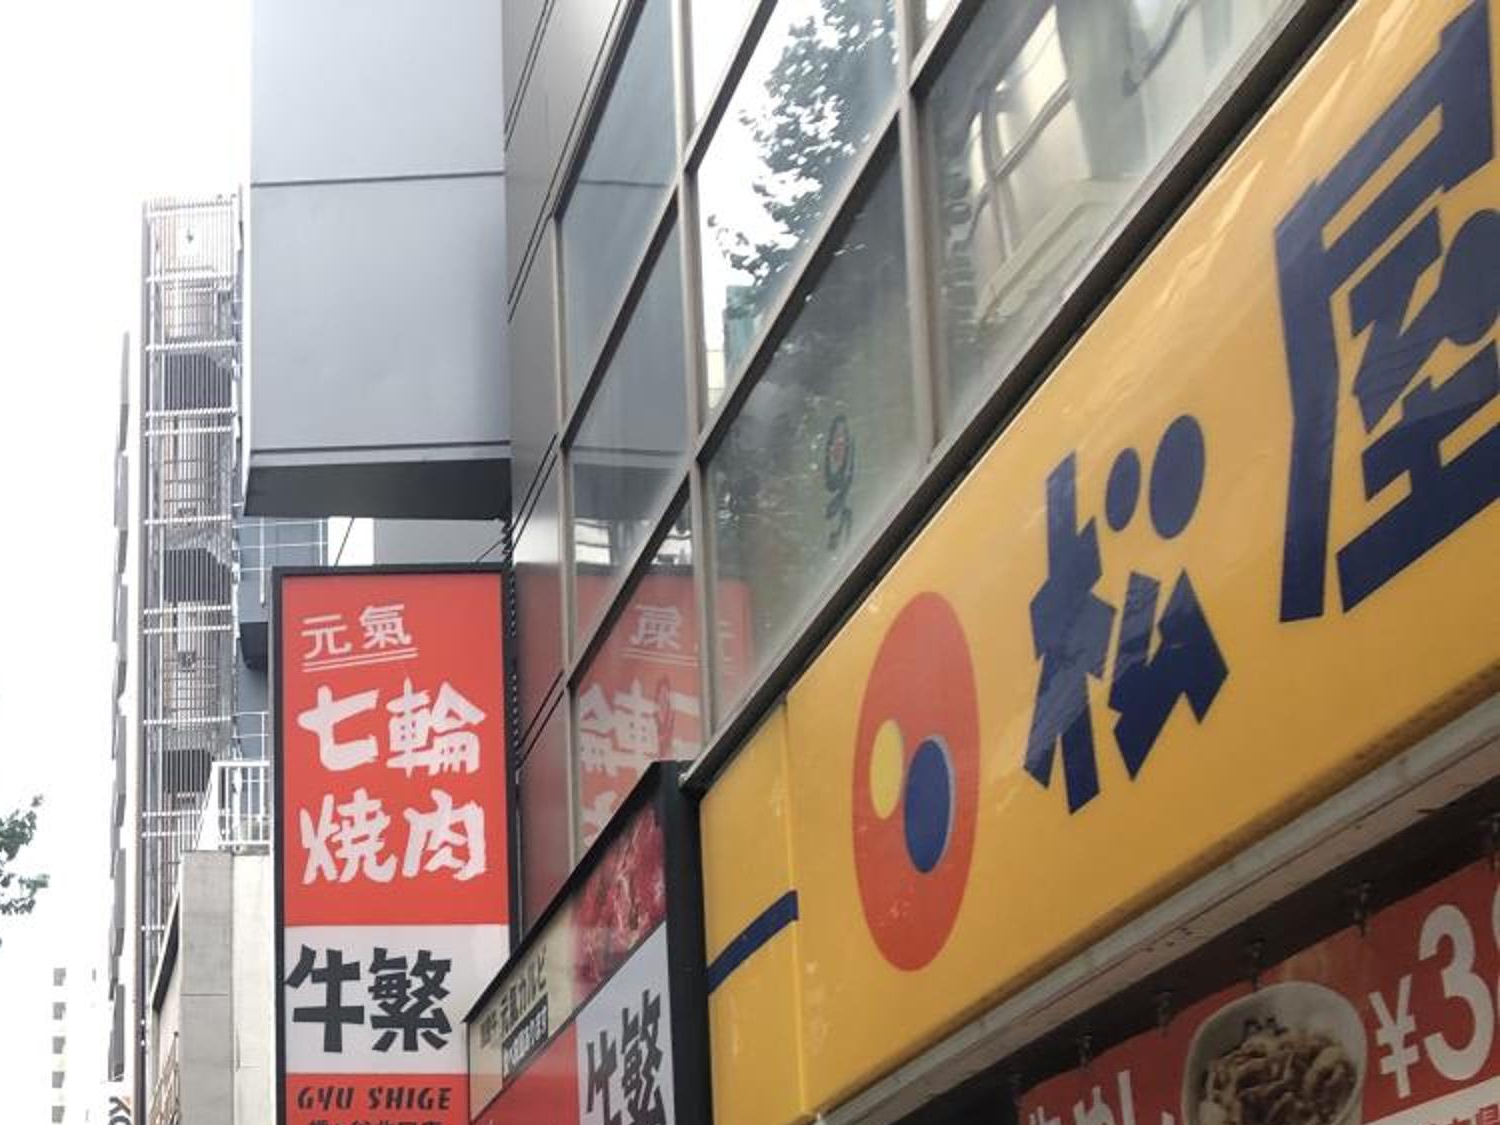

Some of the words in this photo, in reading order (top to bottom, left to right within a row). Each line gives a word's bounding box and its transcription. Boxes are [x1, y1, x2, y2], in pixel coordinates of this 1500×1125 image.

[1024, 0, 1500, 815] 松屋
[298, 677, 486, 776] 七輪
[300, 788, 487, 886] 焼肉
[285, 944, 454, 1053] 牛繁
[1368, 903, 1500, 1099] ¥3
[297, 1085, 355, 1111] GYU
[368, 1085, 452, 1111] SHIGE
